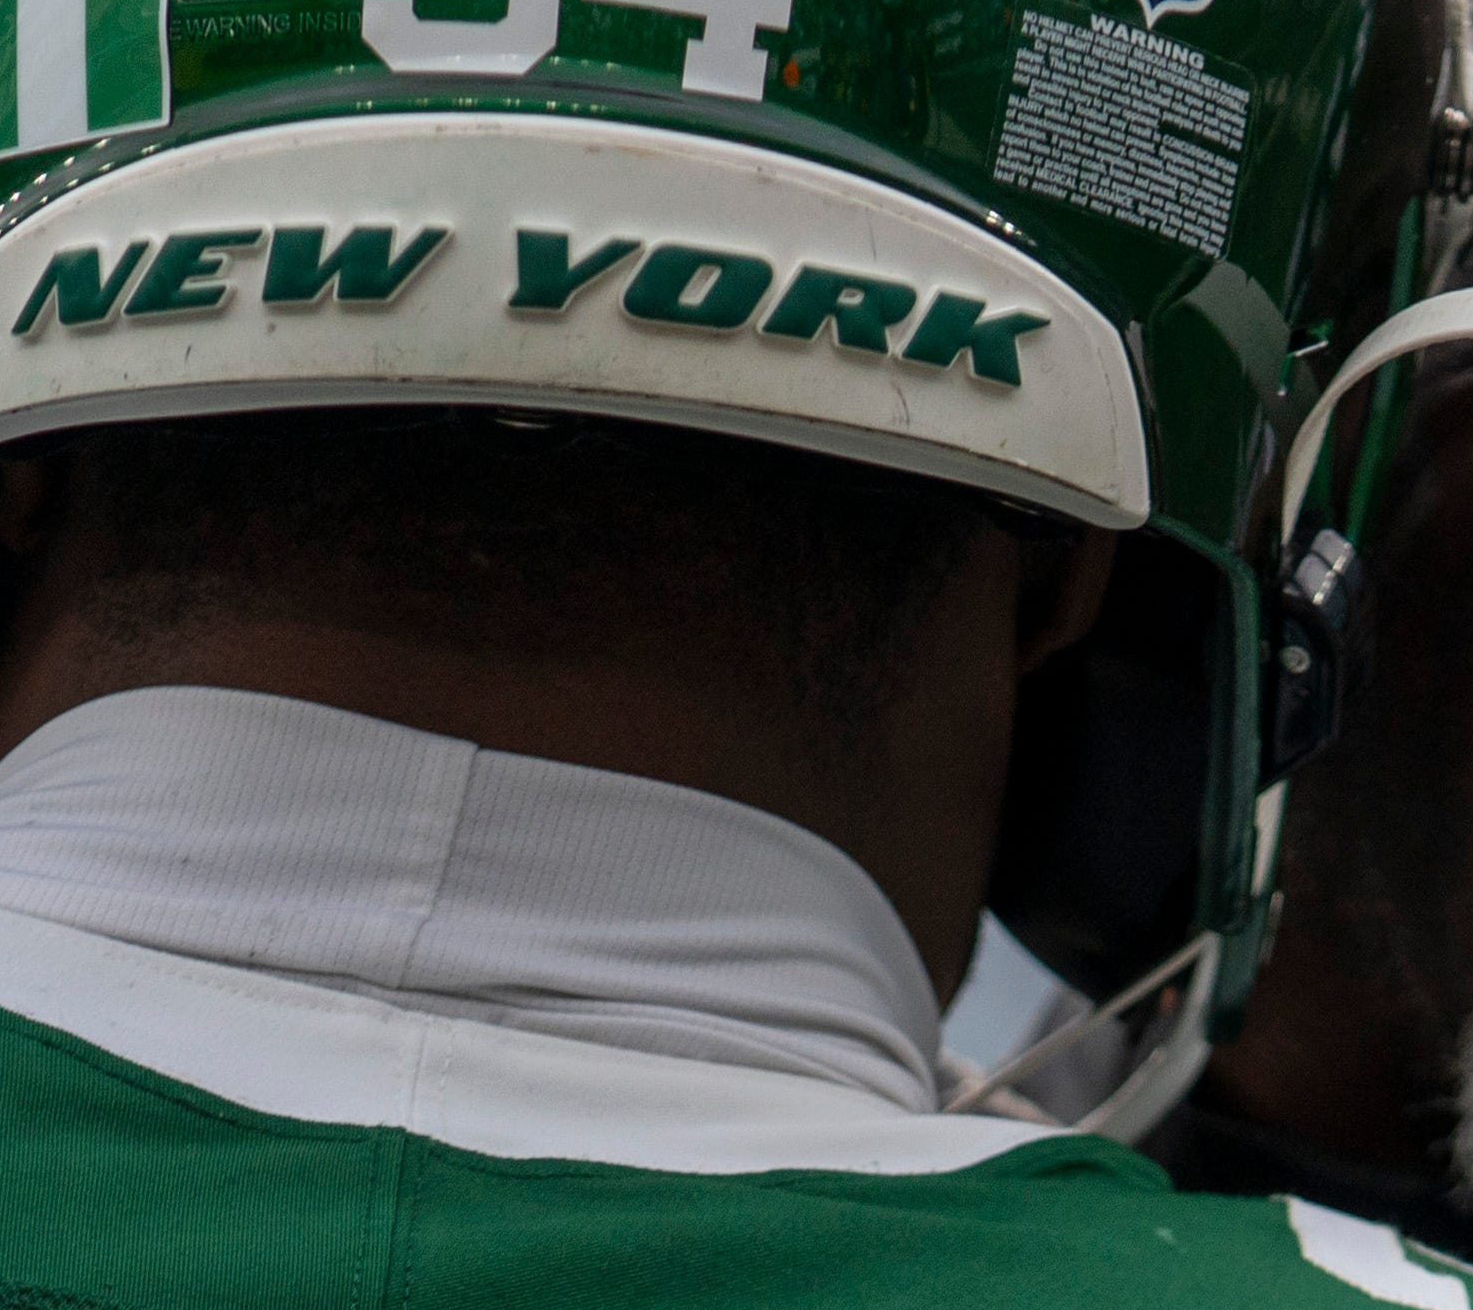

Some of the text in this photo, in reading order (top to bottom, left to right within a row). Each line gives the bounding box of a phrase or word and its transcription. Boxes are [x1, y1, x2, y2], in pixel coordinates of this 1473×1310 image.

[187, 13, 290, 40] WARNING
[299, 12, 362, 33] INSID
[1090, 13, 1205, 69] WARNING
[12, 227, 1054, 387] NEW YORK
